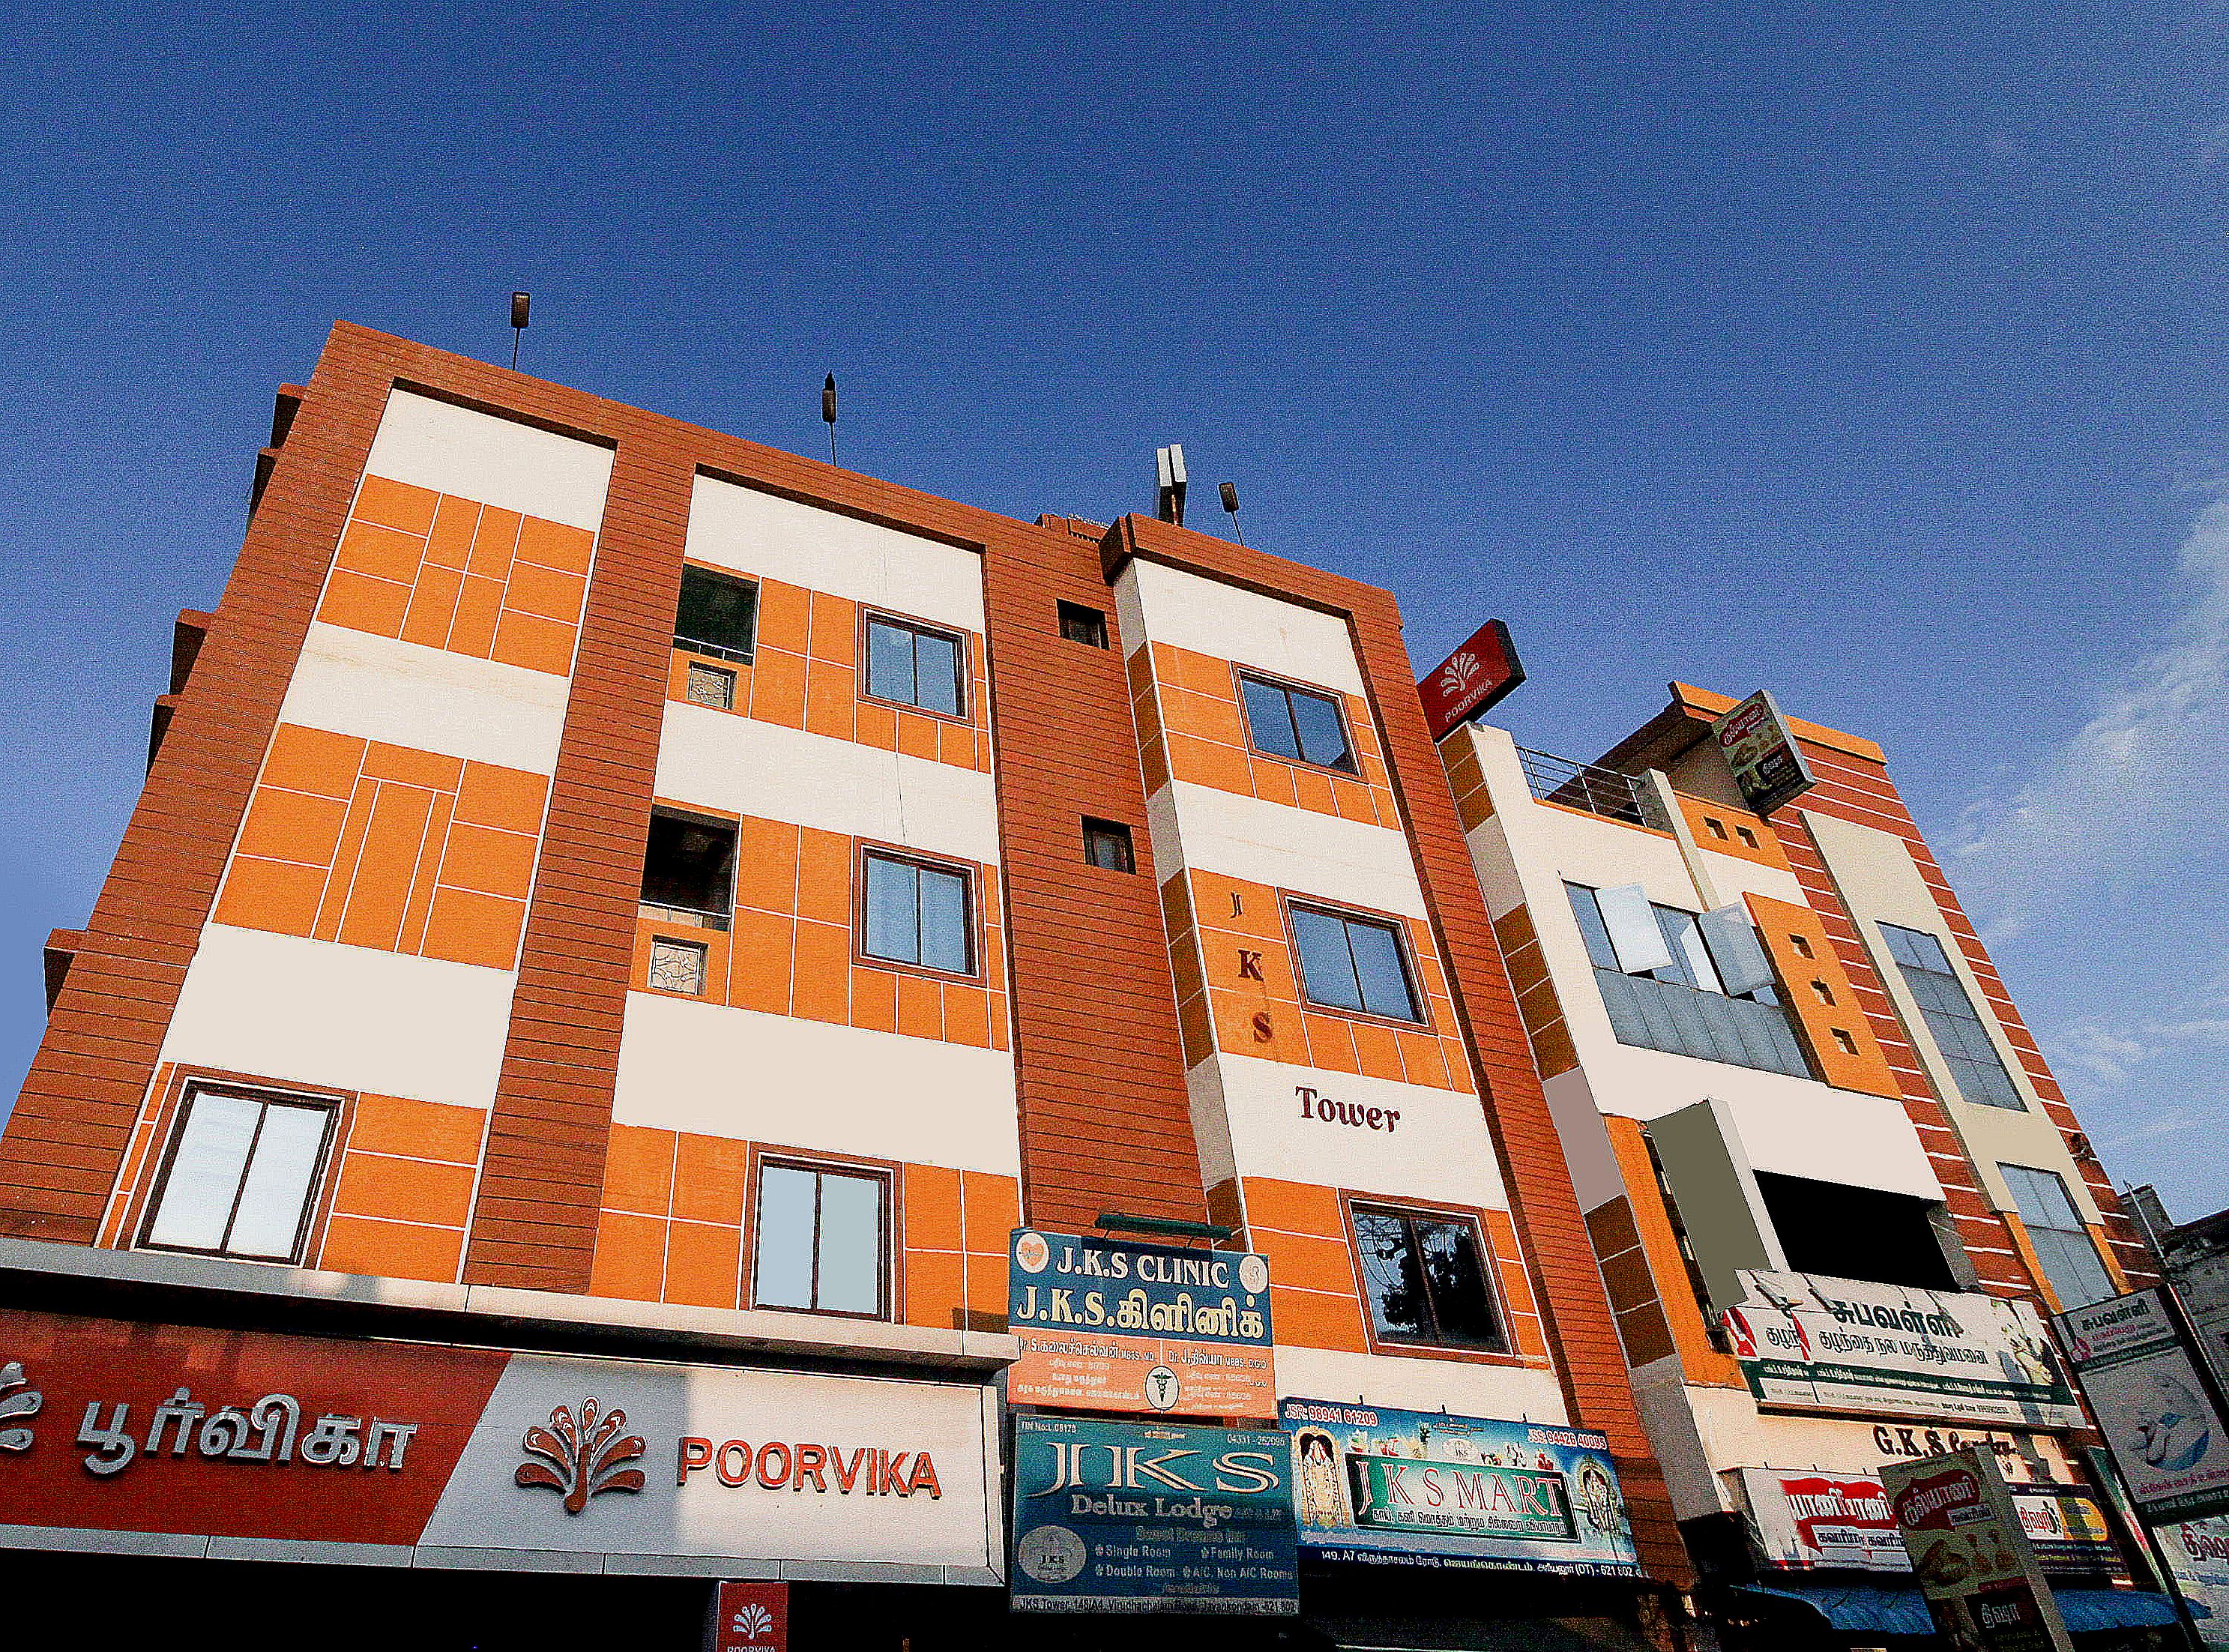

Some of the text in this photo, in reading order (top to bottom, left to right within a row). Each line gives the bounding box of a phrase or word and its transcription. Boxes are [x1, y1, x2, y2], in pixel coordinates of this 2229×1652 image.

[1444, 679, 1493, 722] POORVIKA
[1295, 1086, 1401, 1133] Tower
[1057, 1246, 1231, 1288] J.K.S CLINIC
[77, 1387, 419, 1475] பூர்விகா
[1308, 1405, 1342, 1423] 98941
[676, 1436, 943, 1499] POORVIKA
[1024, 1441, 1280, 1498] JKS
[1070, 1494, 1148, 1517] Delux
[1155, 1497, 1233, 1528] Lodge
[1453, 1471, 1563, 1518] MART
[1105, 1544, 1171, 1559] Single Room
[1210, 1546, 1274, 1561] Family Room
[1106, 1564, 1175, 1578] Double Room
[1216, 1567, 1237, 1579] Non
[1260, 1567, 1294, 1580] Rooms
[1021, 1598, 1039, 1610] JKS
